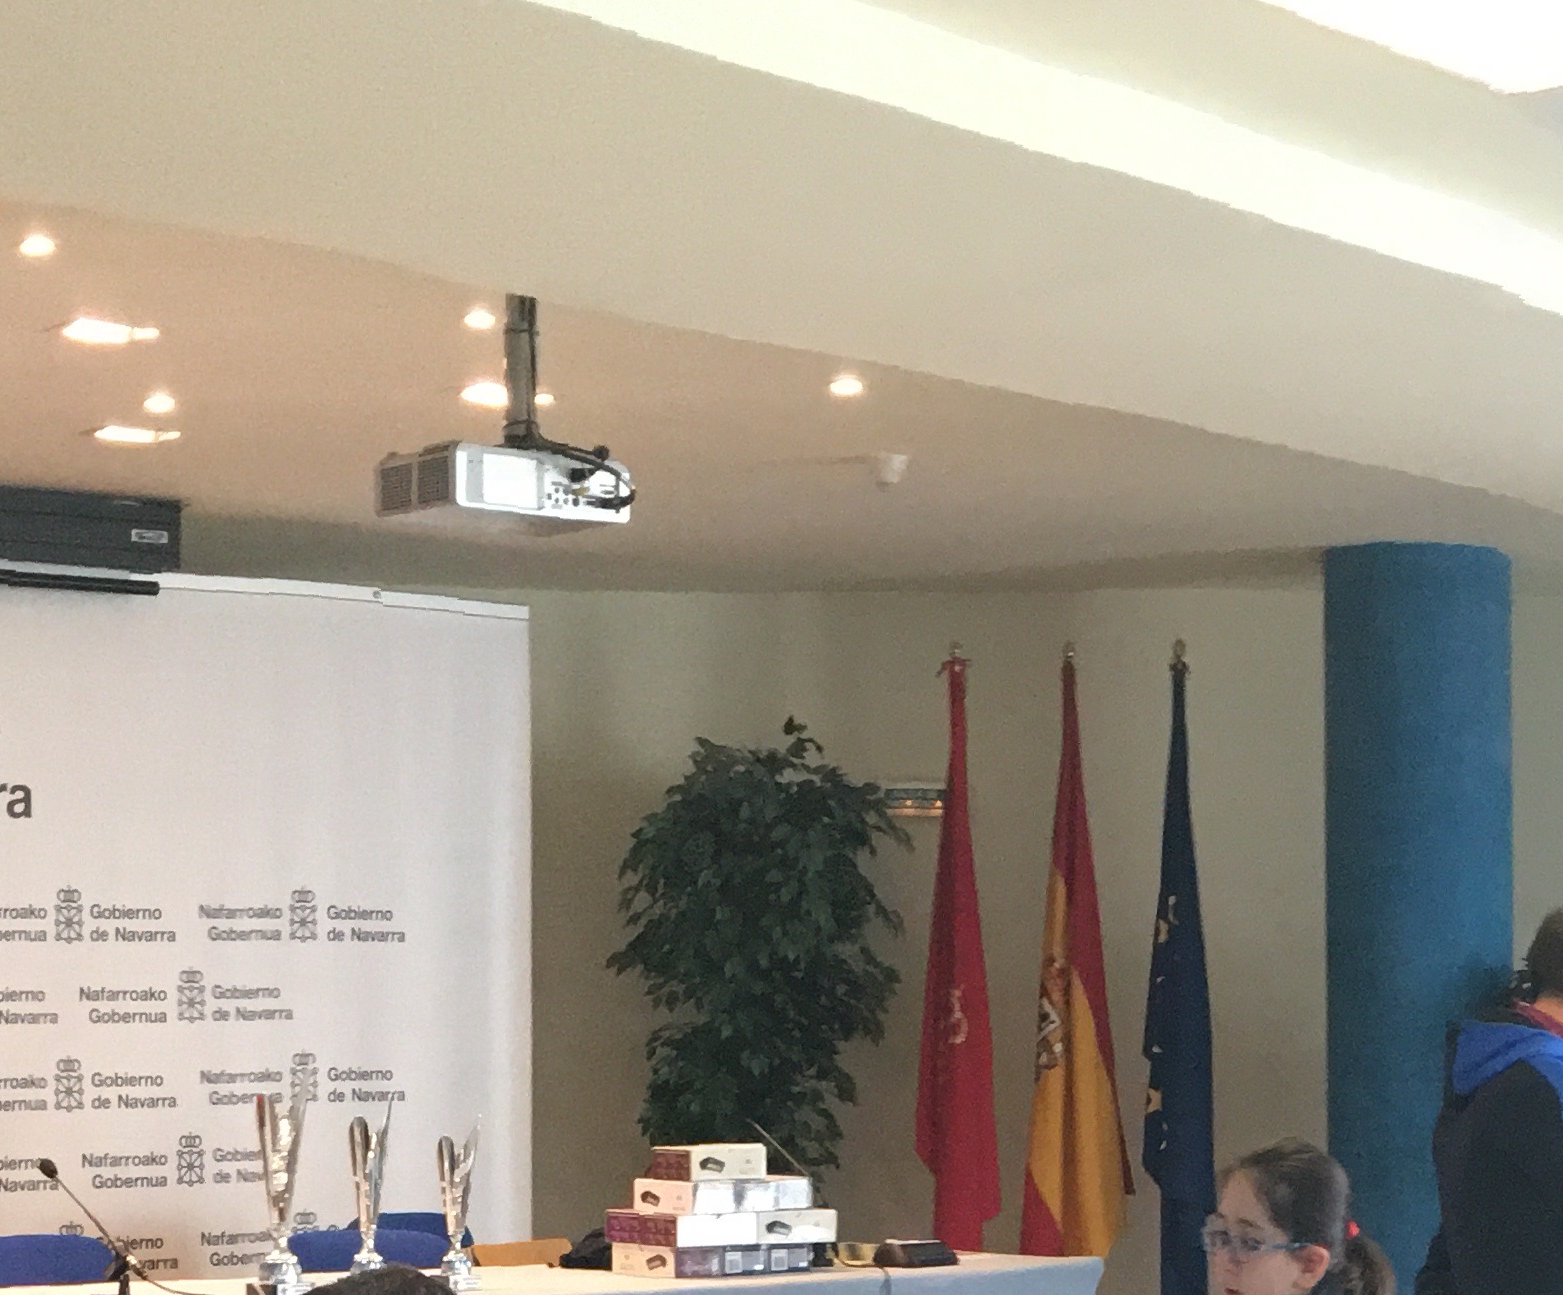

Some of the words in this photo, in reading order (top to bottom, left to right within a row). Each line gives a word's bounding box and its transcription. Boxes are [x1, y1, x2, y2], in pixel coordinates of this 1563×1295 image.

[90, 904, 162, 920] Gobierno
[199, 904, 283, 919] Nafarroako
[327, 905, 393, 921] Gobierno
[90, 926, 109, 942] de
[115, 927, 176, 942] Navarra
[208, 926, 282, 941] Gobernua
[327, 927, 345, 942] de
[351, 927, 405, 942] Navarra
[79, 986, 167, 1001] Nafarroako
[212, 984, 280, 999] Gobierno
[89, 1008, 167, 1024] Gobernua
[212, 1007, 230, 1021] de
[235, 1007, 293, 1021] Navarra
[91, 1072, 163, 1087] Gobierno
[328, 1067, 393, 1082] Gobierno
[91, 1095, 111, 1110] de
[118, 1094, 176, 1109] Navarra
[328, 1088, 345, 1102] de
[82, 1151, 168, 1168] Nafarroako
[92, 1174, 167, 1189] Gobernua
